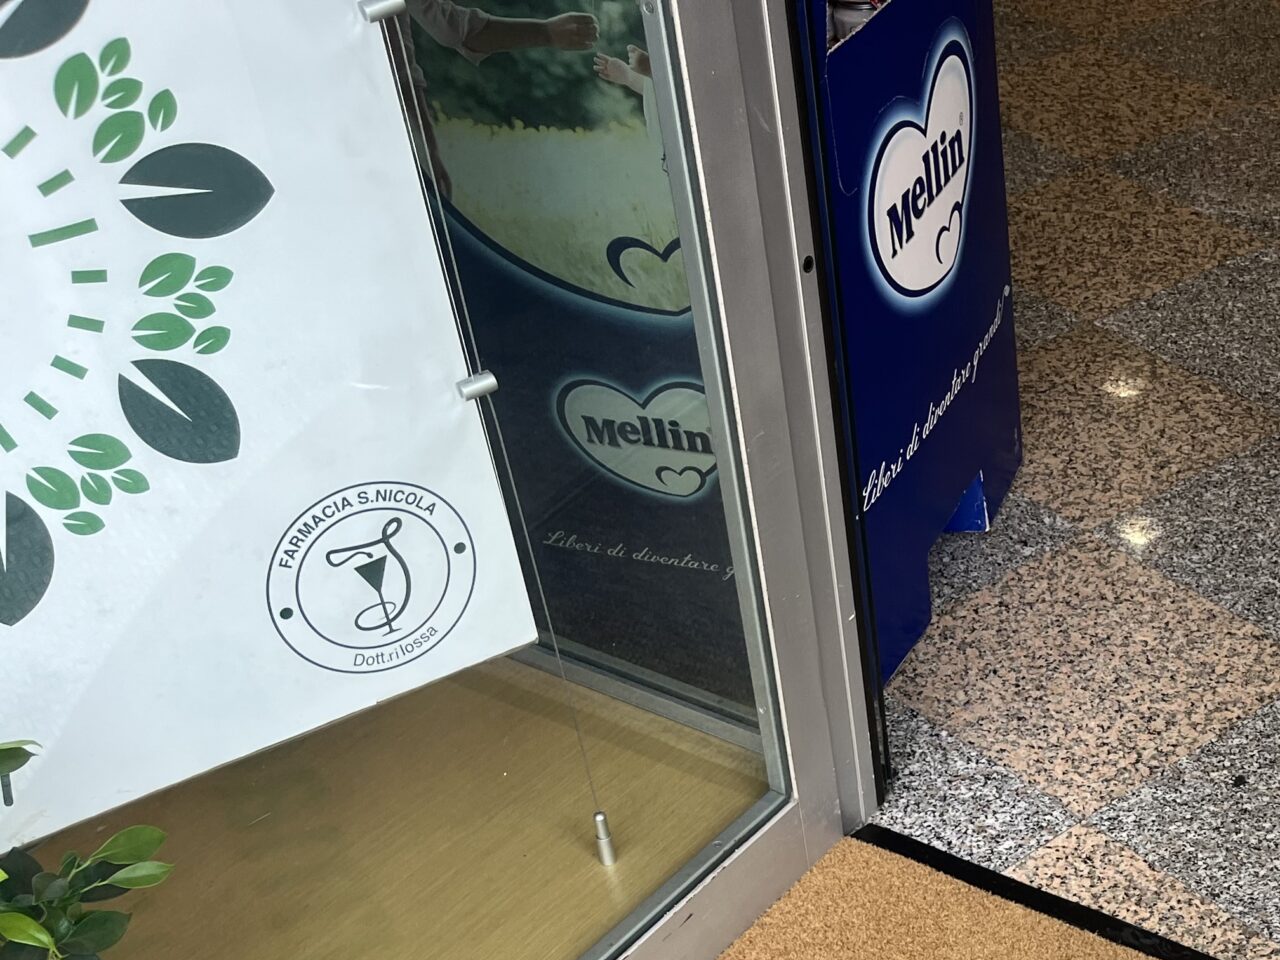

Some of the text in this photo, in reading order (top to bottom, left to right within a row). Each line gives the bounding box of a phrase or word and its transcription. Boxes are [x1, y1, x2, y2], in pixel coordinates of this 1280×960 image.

[887, 129, 964, 259] Mellin
[581, 414, 714, 455] Mellin
[862, 285, 1010, 512] Liberi di diventare grandi
[278, 488, 437, 569] FARMACIA S.NICOLA
[542, 530, 602, 554] Liberi
[607, 543, 627, 558] di
[632, 547, 720, 573] diventare
